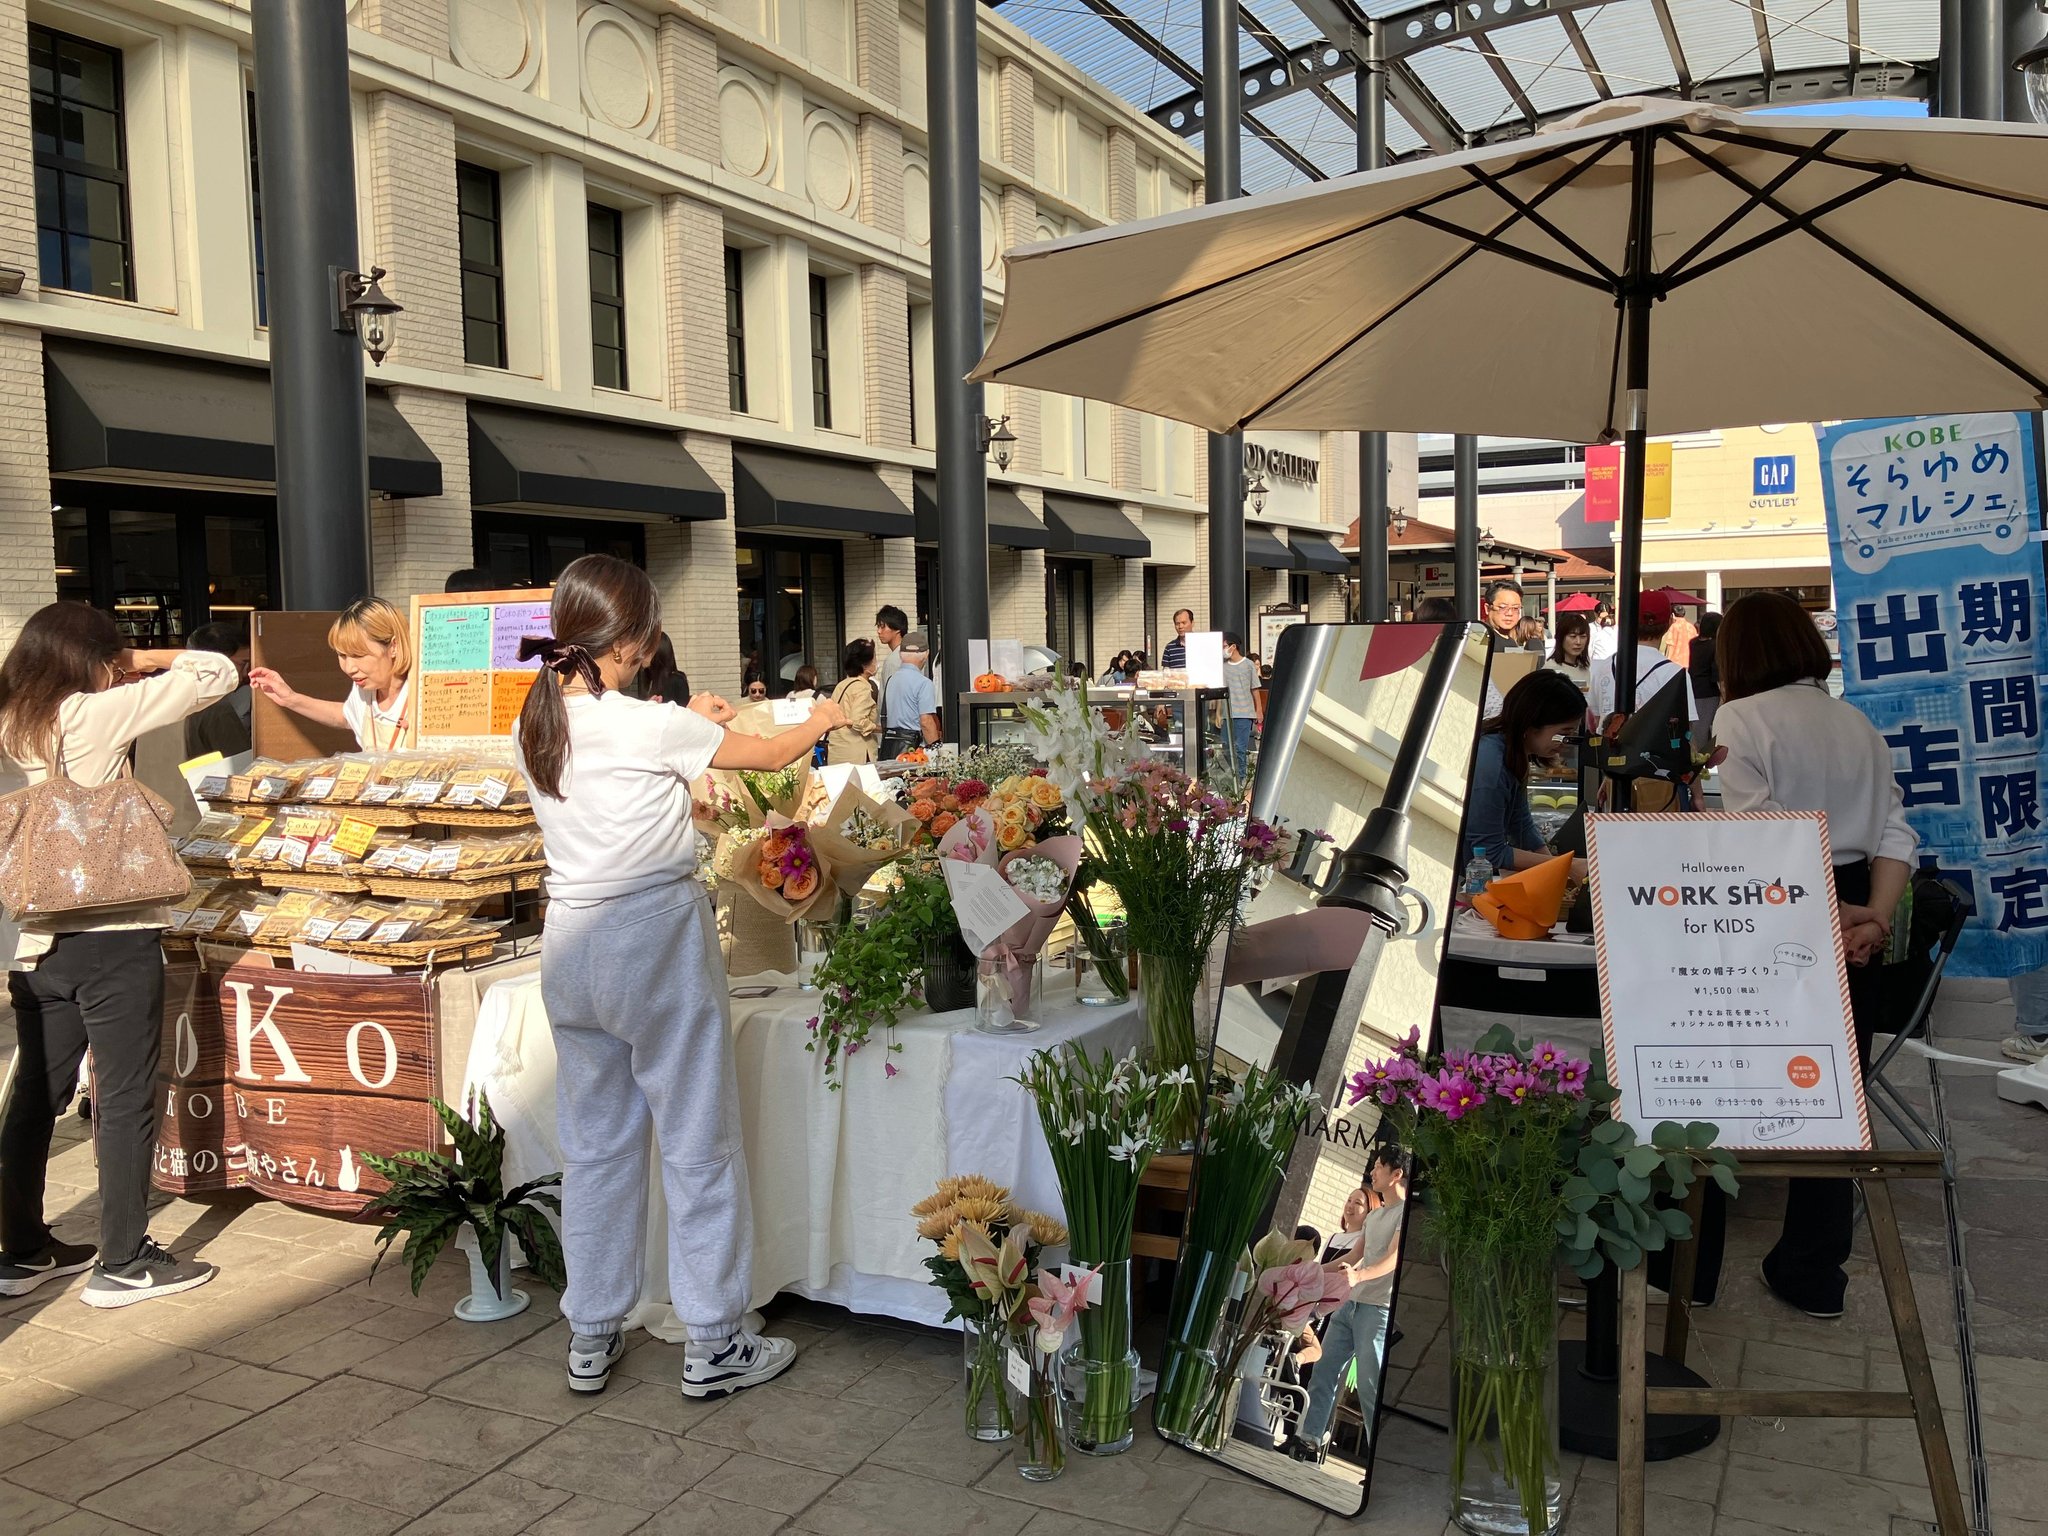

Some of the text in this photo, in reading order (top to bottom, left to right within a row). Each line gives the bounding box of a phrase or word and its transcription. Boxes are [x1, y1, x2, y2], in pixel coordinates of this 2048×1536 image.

[1884, 424, 1962, 453] KOBE
[1267, 449, 1320, 483] GALLERY
[1761, 463, 1789, 487] GAP
[1846, 443, 2009, 497] そらゆめ
[1750, 497, 1799, 509] OUTLET
[1857, 491, 2006, 529] マルシェ
[1877, 522, 1992, 544] kobe sorayume marche
[1957, 578, 2048, 933] 期間限定
[1681, 862, 1745, 873] Halloween
[1628, 885, 1805, 906] WORK SHOP
[1684, 917, 1755, 934] for KIDS
[1671, 966, 1779, 976] 『魔女の帽子づくり』
[1688, 1009, 1770, 1017] すきなお花を使って
[166, 1089, 288, 1125] KOBE
